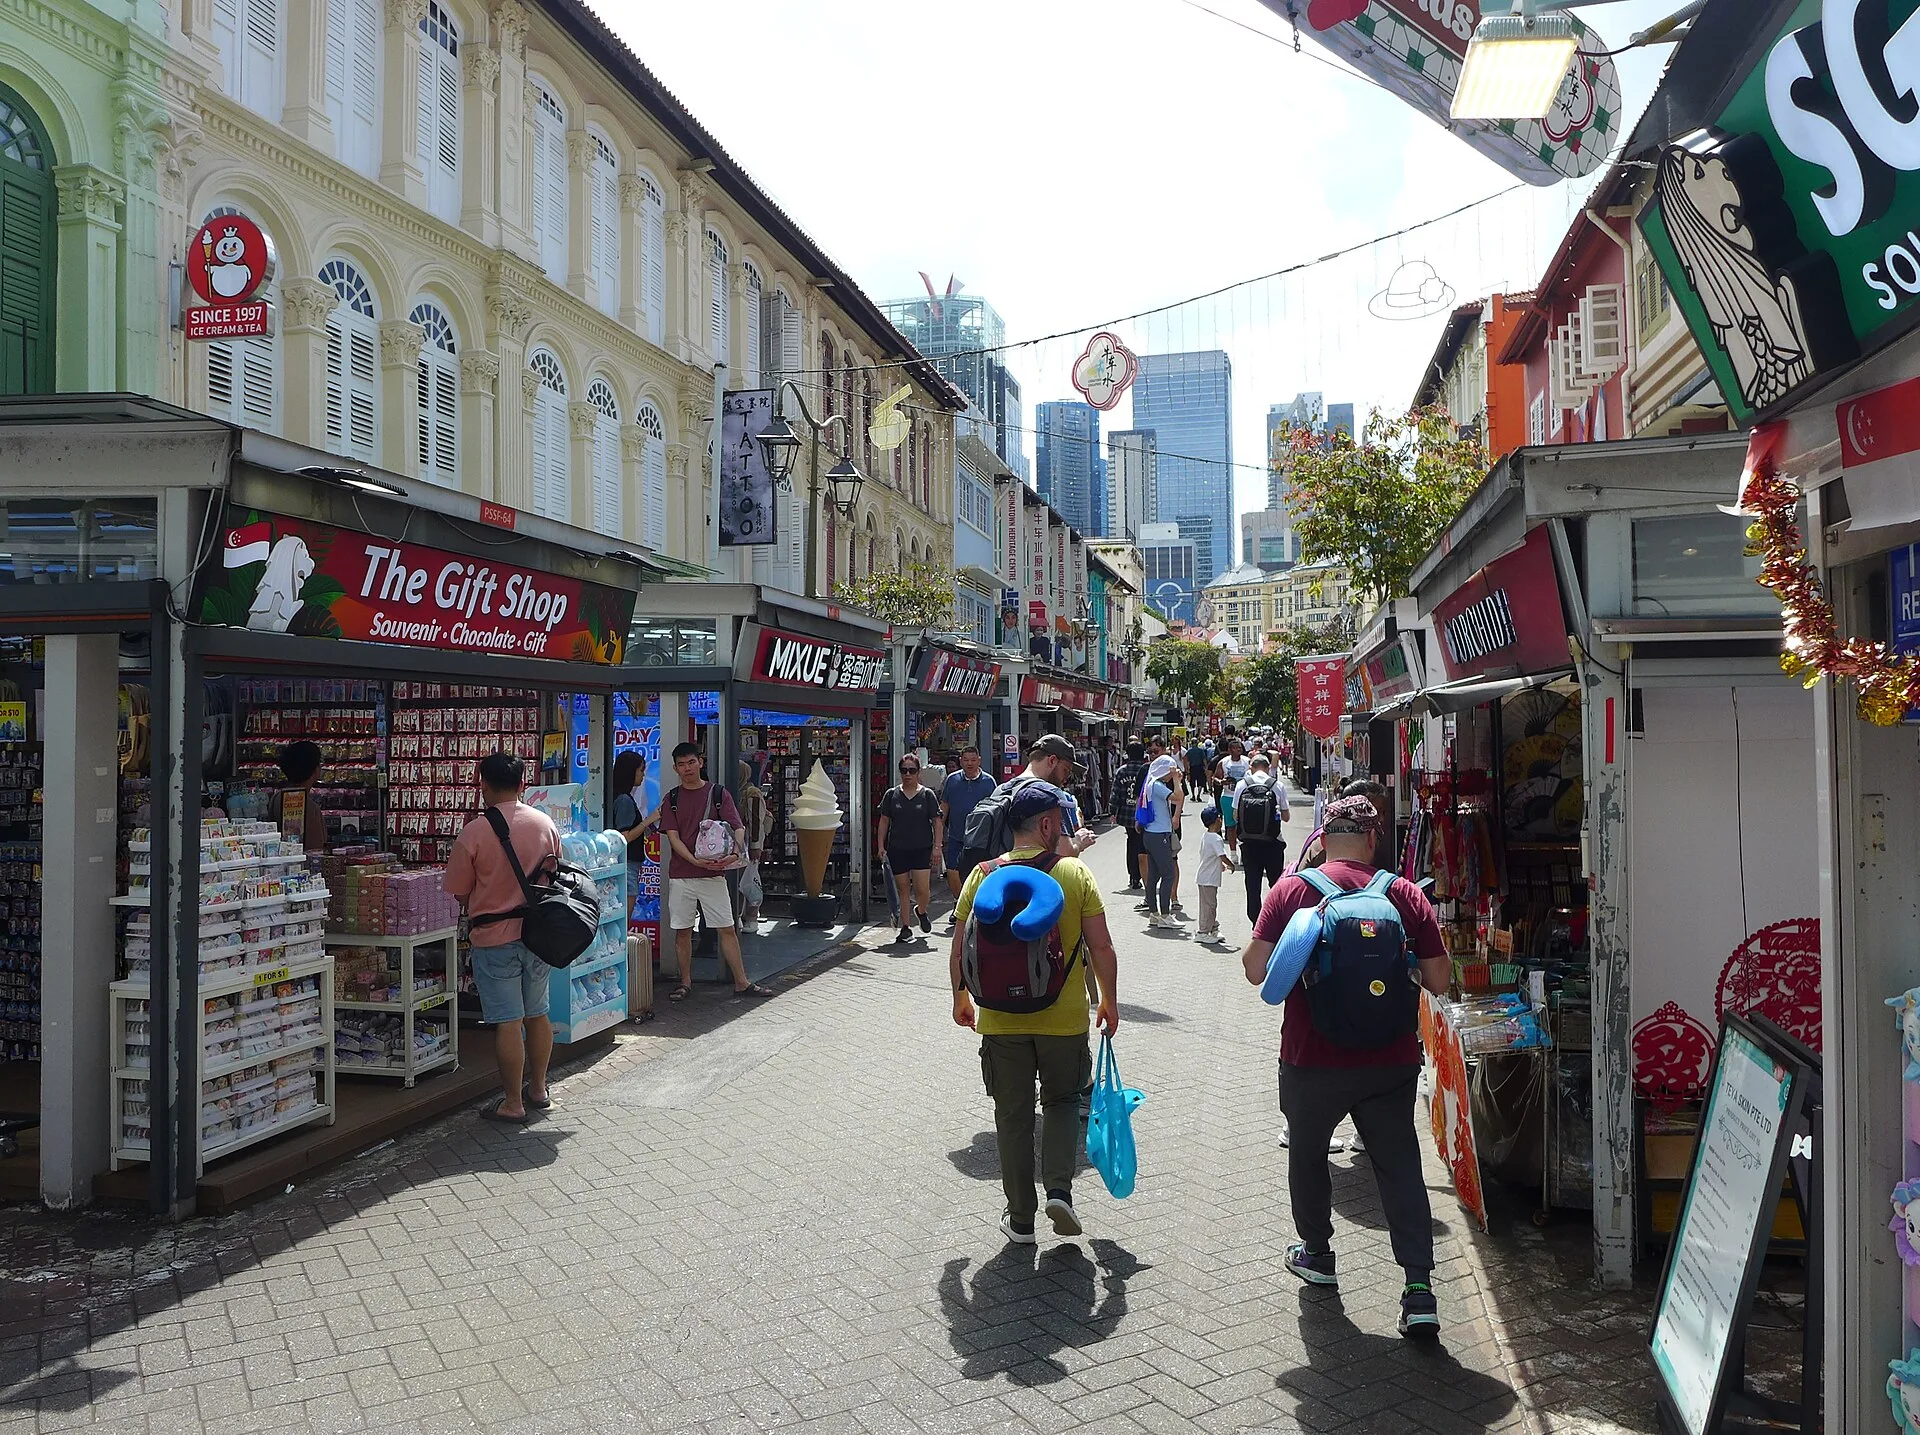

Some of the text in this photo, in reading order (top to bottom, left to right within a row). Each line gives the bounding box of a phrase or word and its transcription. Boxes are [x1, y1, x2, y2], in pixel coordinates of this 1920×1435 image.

[190, 323, 262, 336] ICE CREAM & TEA
[191, 306, 262, 324] SINCE 1997
[739, 410, 754, 536] TATTOO
[484, 506, 512, 524] PSSF-64
[1008, 490, 1016, 582] CHINATOWN HERITAGE CENTRE
[360, 544, 568, 632] The Gift Shop
[369, 612, 548, 655] Souvenir Chocolate Gift
[768, 637, 832, 684] MIXUE
[8, 708, 20, 717] $10
[1312, 673, 1332, 717] 吉祥苑
[258, 969, 286, 982] 1 FOR $1
[1737, 1094, 1752, 1115] SKIN
[1750, 1106, 1762, 1125] PTE
[1760, 1115, 1772, 1134] LTD
